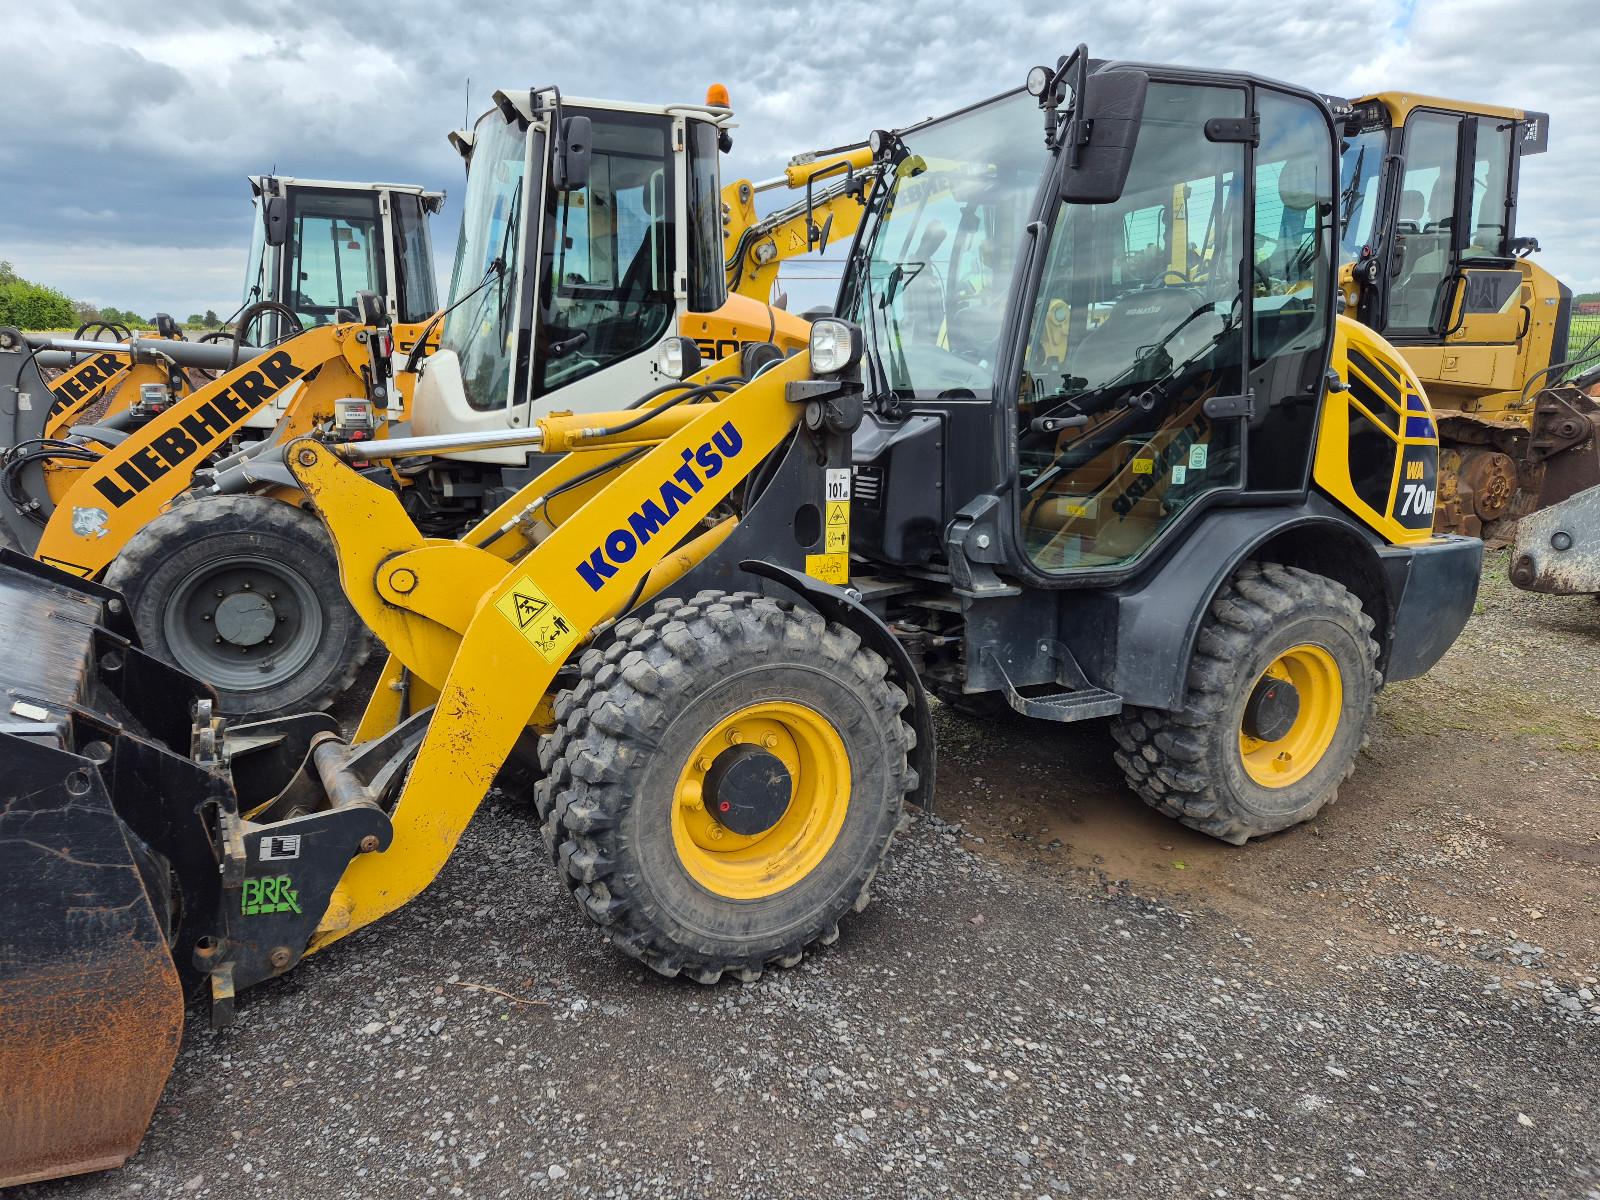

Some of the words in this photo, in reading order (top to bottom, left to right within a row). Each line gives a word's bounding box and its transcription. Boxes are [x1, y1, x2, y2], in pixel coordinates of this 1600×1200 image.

[1468, 275, 1503, 309] CAT
[47, 353, 128, 421] HERR
[94, 350, 304, 508] LIEBHERR
[1406, 461, 1424, 480] WA
[575, 420, 743, 592] KOMATSU
[828, 482, 843, 498] 101
[1400, 484, 1435, 516] 70M
